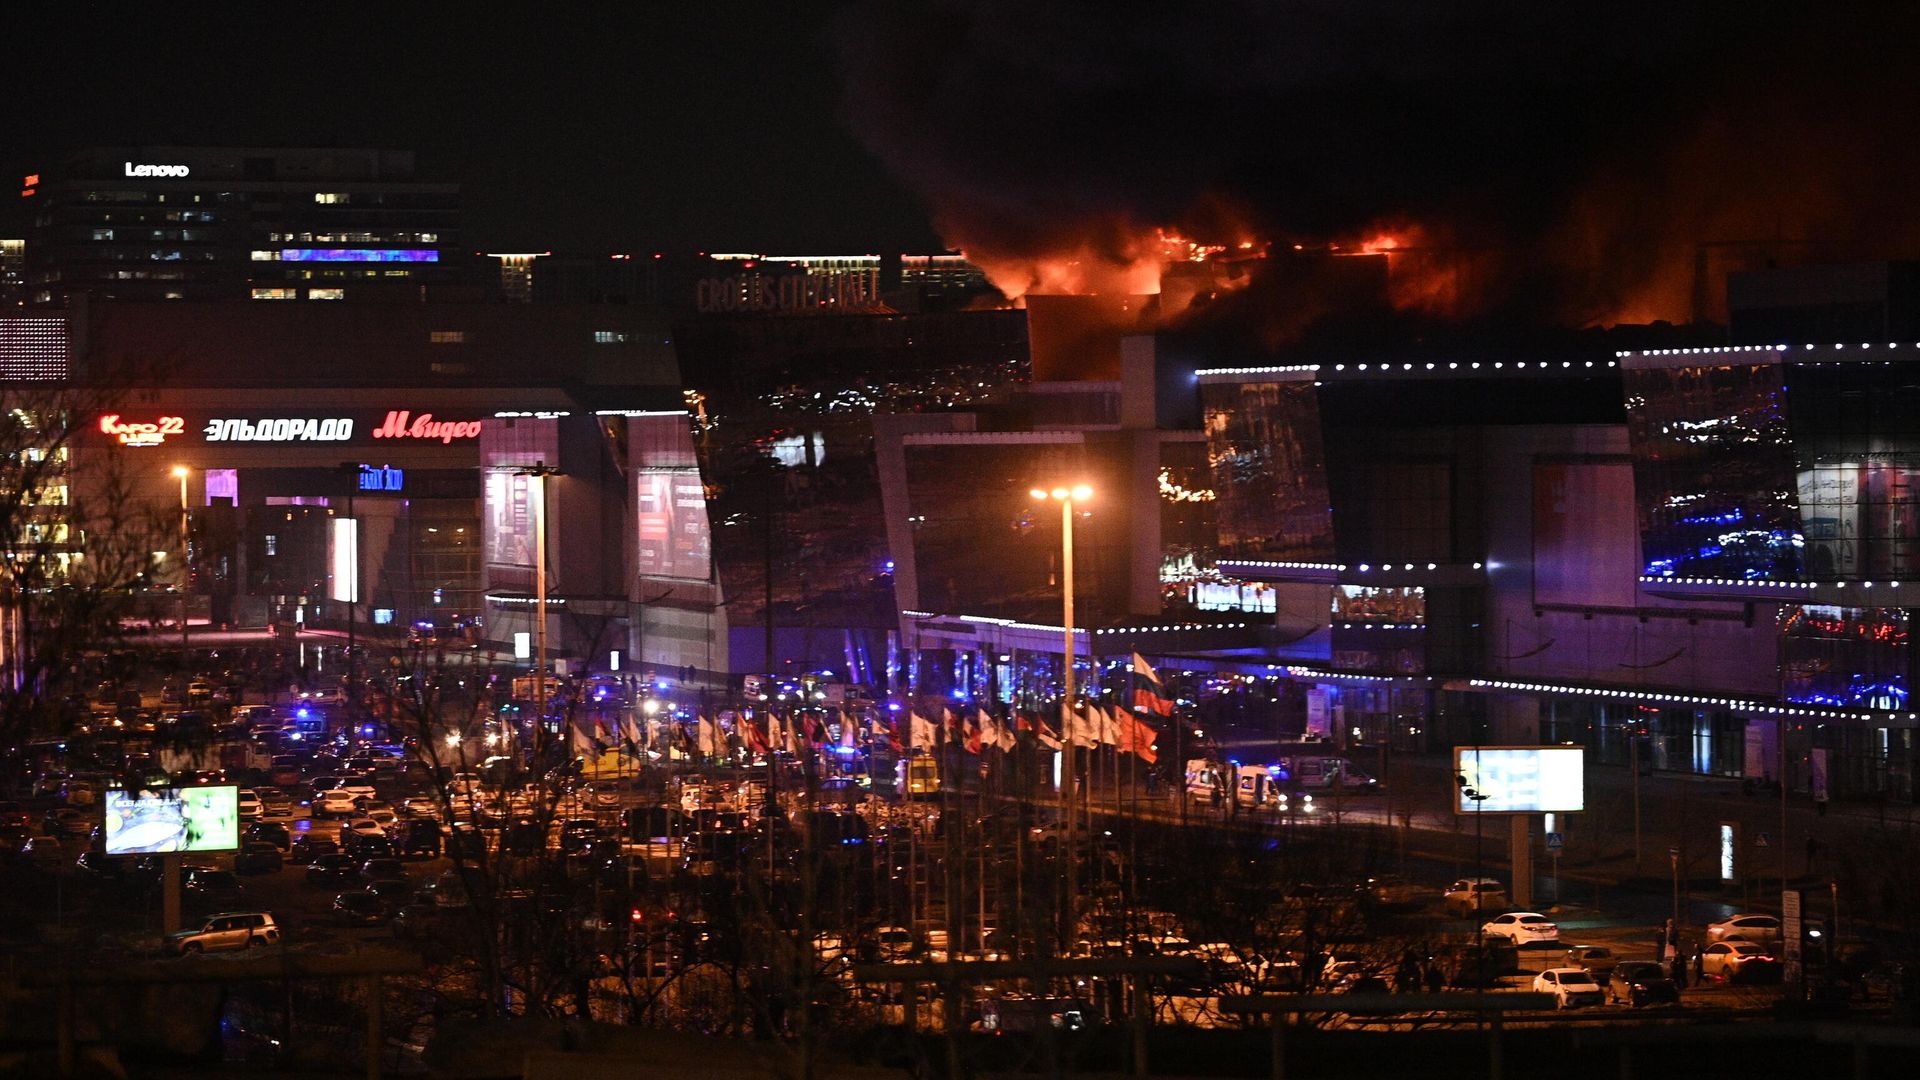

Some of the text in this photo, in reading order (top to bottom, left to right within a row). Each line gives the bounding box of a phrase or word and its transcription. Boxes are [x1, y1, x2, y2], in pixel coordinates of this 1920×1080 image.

[125, 161, 190, 177] Lenovo
[159, 416, 184, 434] 22
[203, 418, 354, 441] ЭЛЬДОРАДО
[373, 410, 482, 444] М.видео
